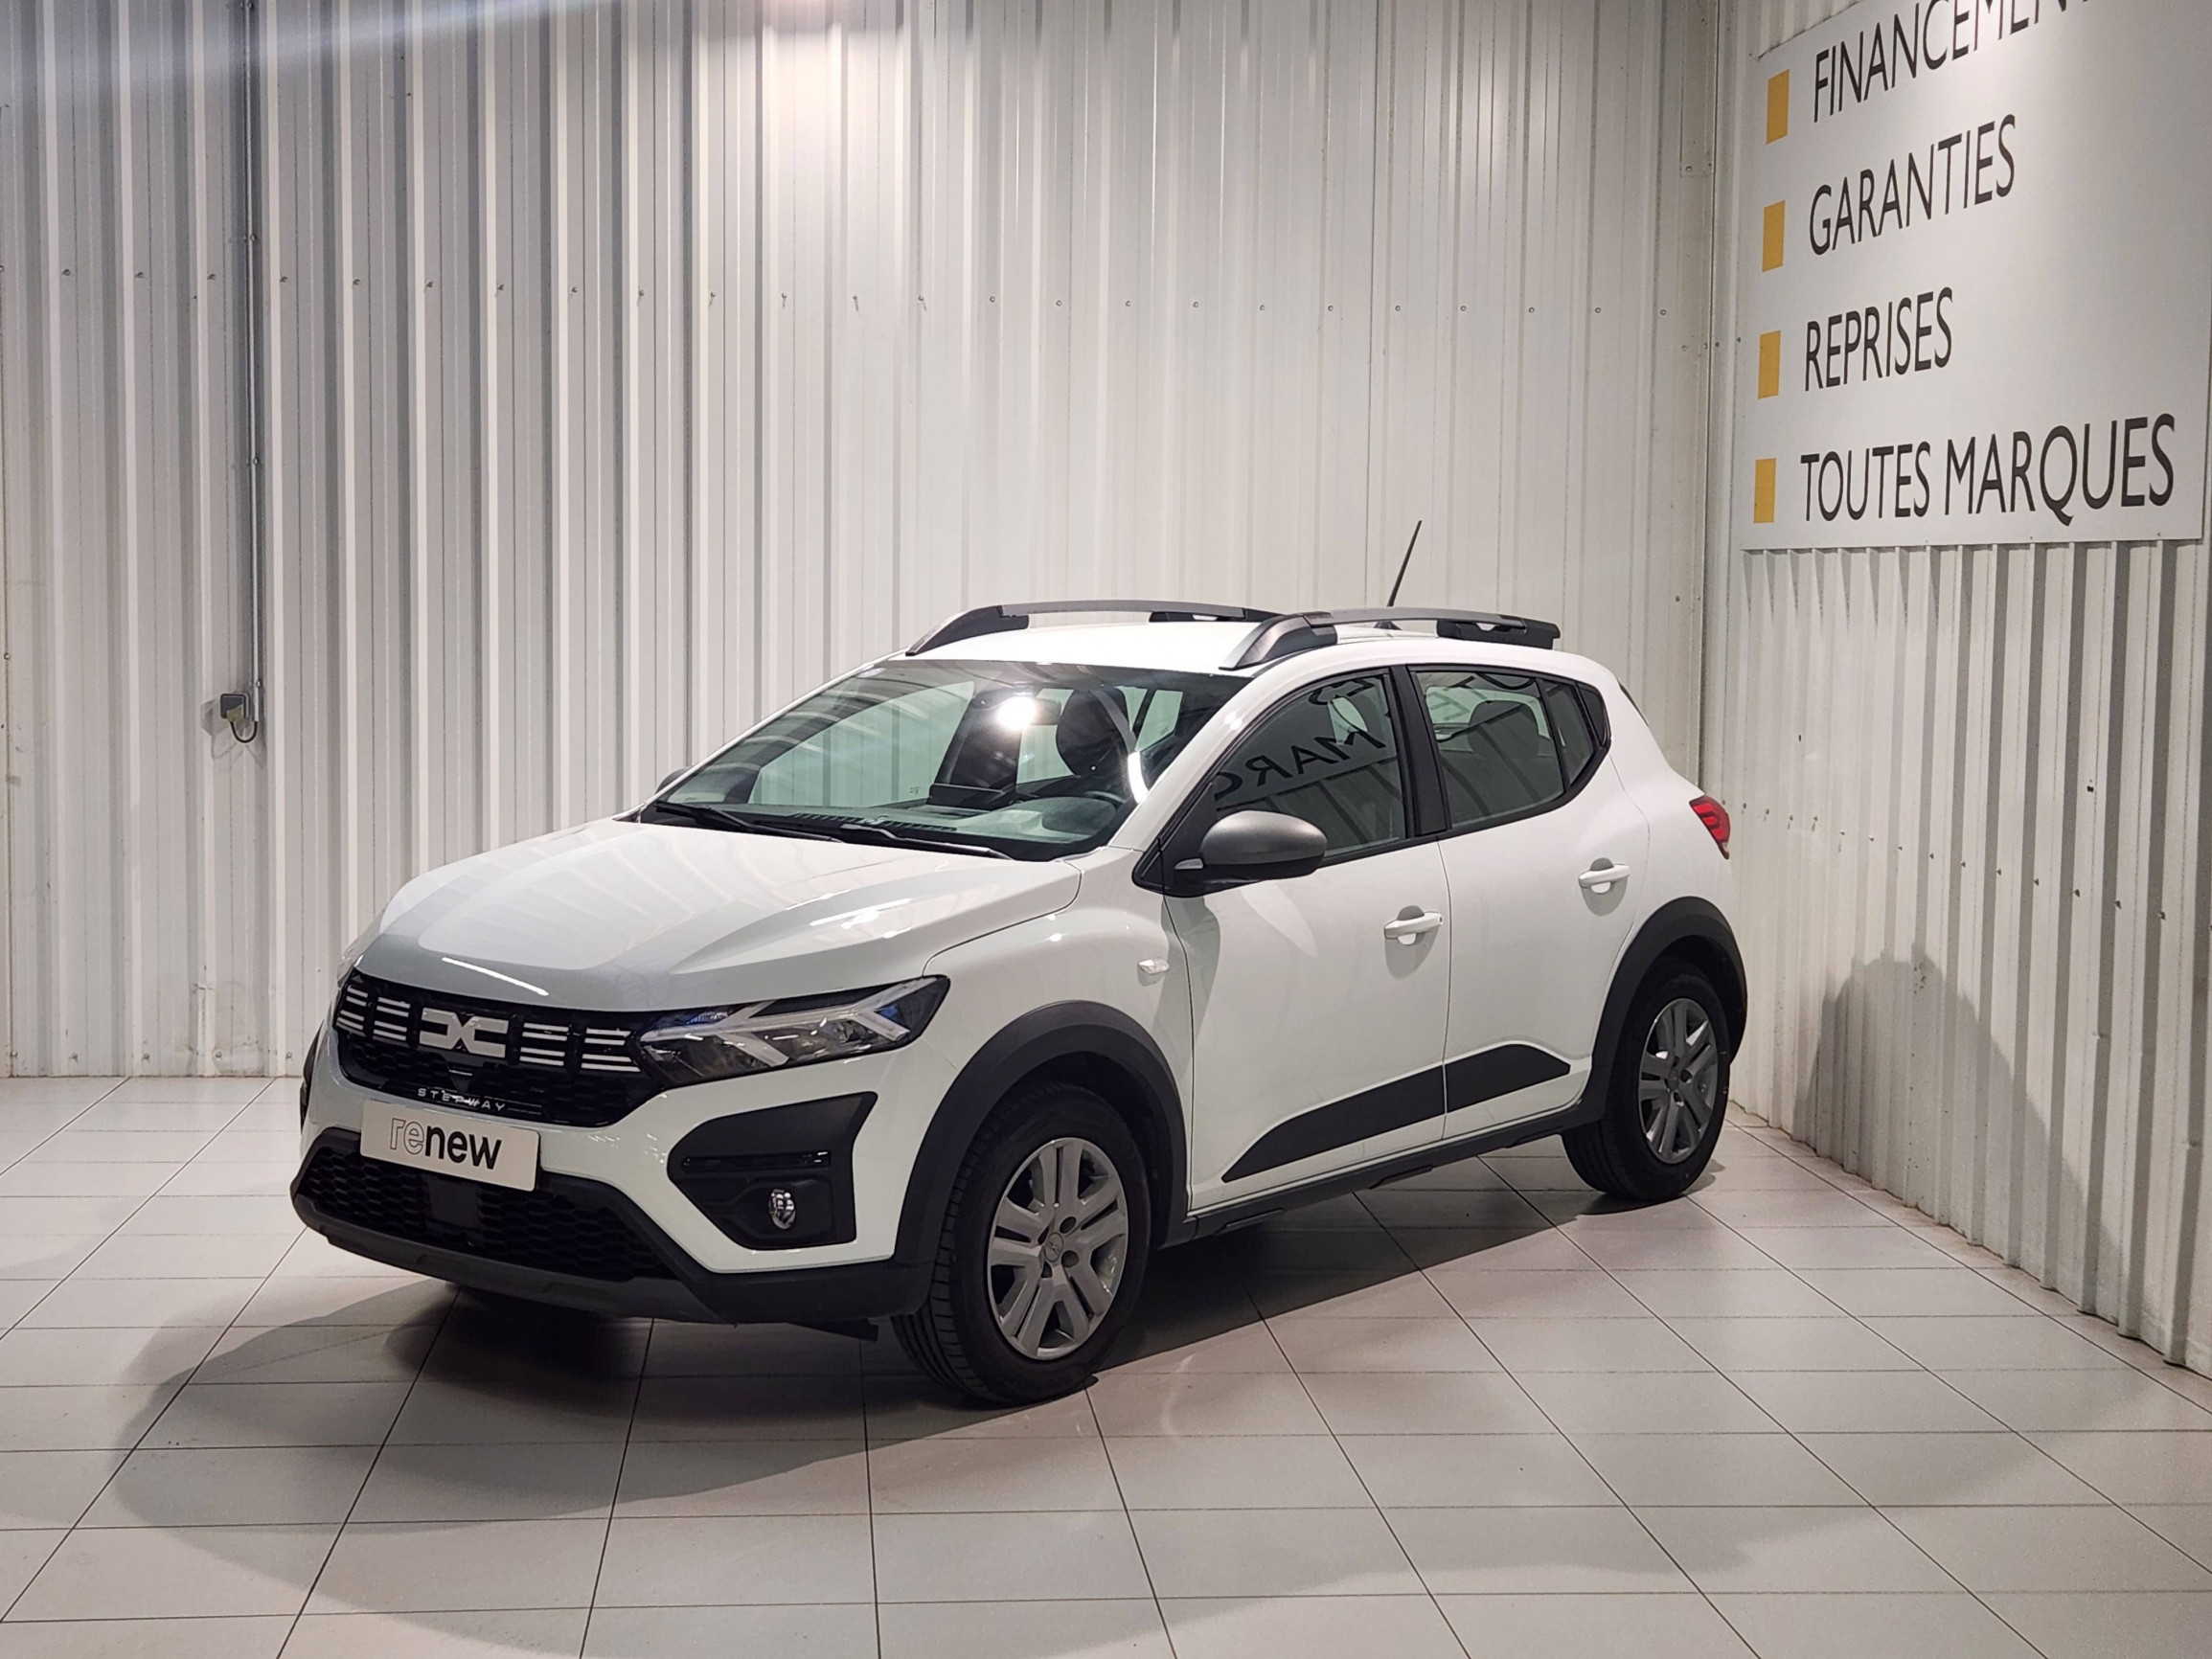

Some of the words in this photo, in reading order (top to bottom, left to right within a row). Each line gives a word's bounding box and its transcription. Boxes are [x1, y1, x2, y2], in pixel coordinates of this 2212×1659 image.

[1813, 0, 2089, 123] FINANCEM
[1809, 114, 2016, 256] GARANTIES
[1805, 287, 1953, 392] REPRISES
[1800, 441, 1931, 522] TOUTES
[1945, 413, 2176, 527] MARQUES
[389, 1117, 502, 1170] renew
[418, 1087, 505, 1111] STEPWAY
